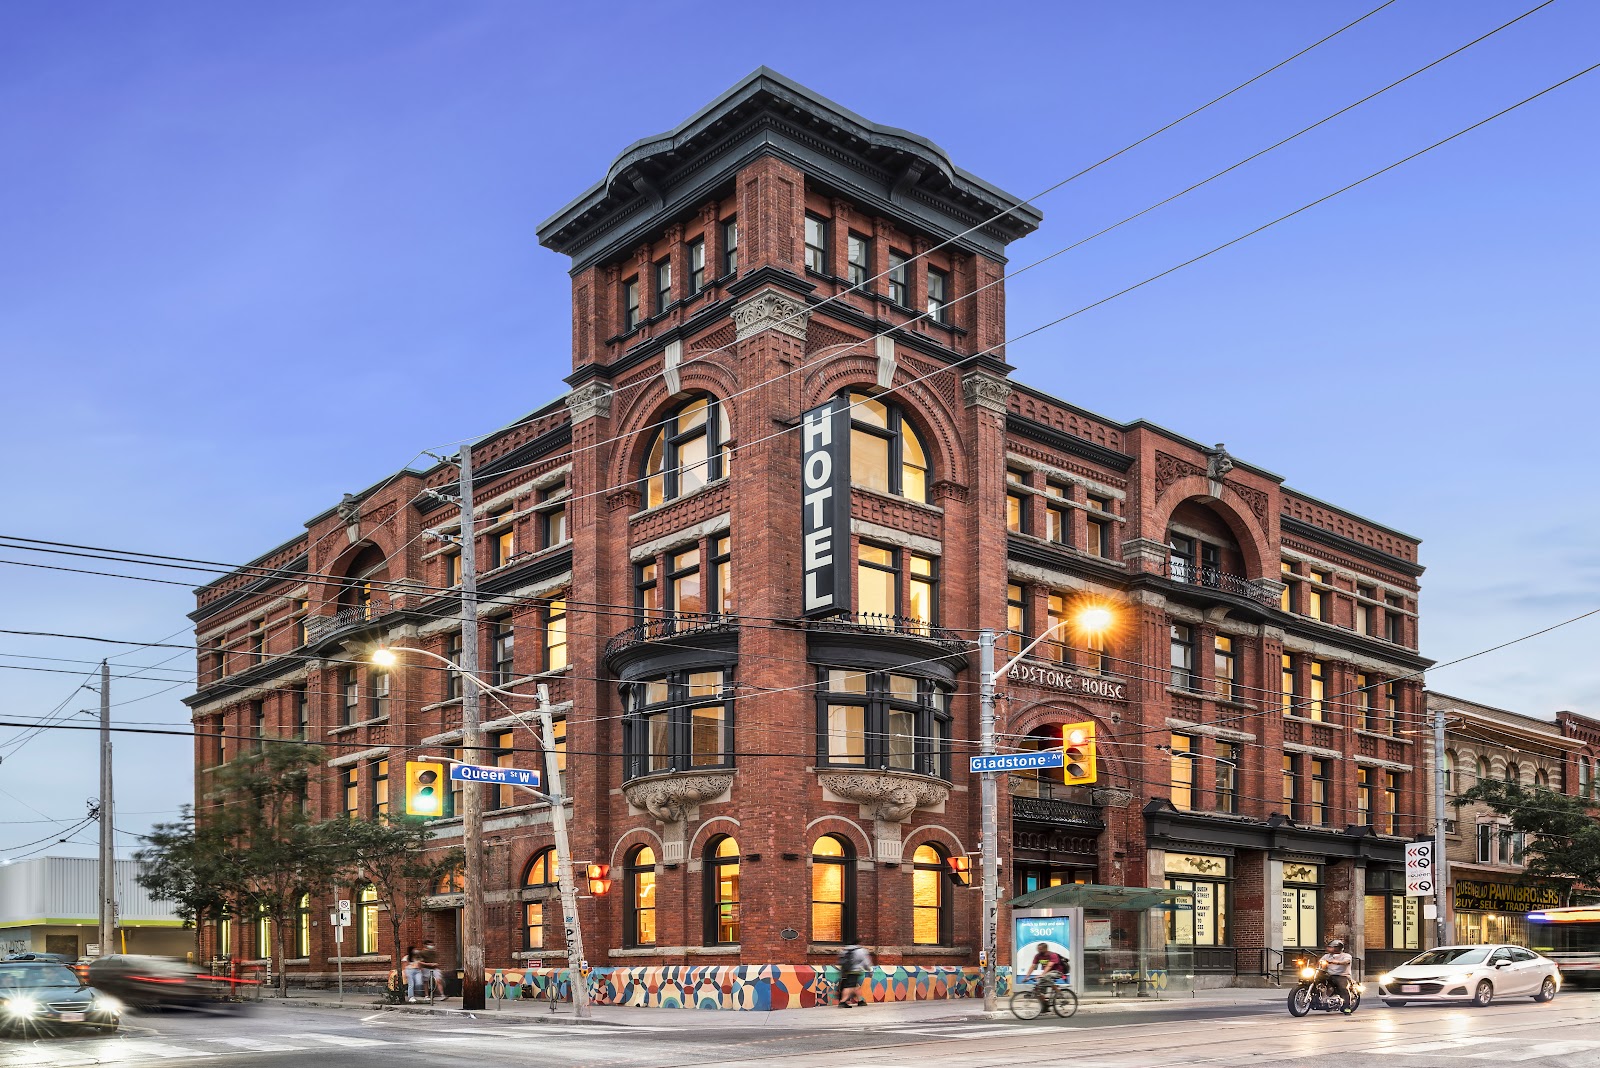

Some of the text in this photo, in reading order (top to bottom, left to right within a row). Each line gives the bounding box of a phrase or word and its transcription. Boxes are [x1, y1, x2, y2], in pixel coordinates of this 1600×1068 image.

[803, 406, 833, 611] HOTEL
[1007, 663, 1125, 700] ADSTONE HOUSE
[972, 755, 1046, 769] Gladstone
[461, 766, 506, 781] Queen
[519, 771, 530, 783] W
[1489, 883, 1559, 905] PAWNBROKERS
[1455, 897, 1474, 908] BUY
[1479, 899, 1499, 910] SELL
[1505, 901, 1530, 912] TRADE
